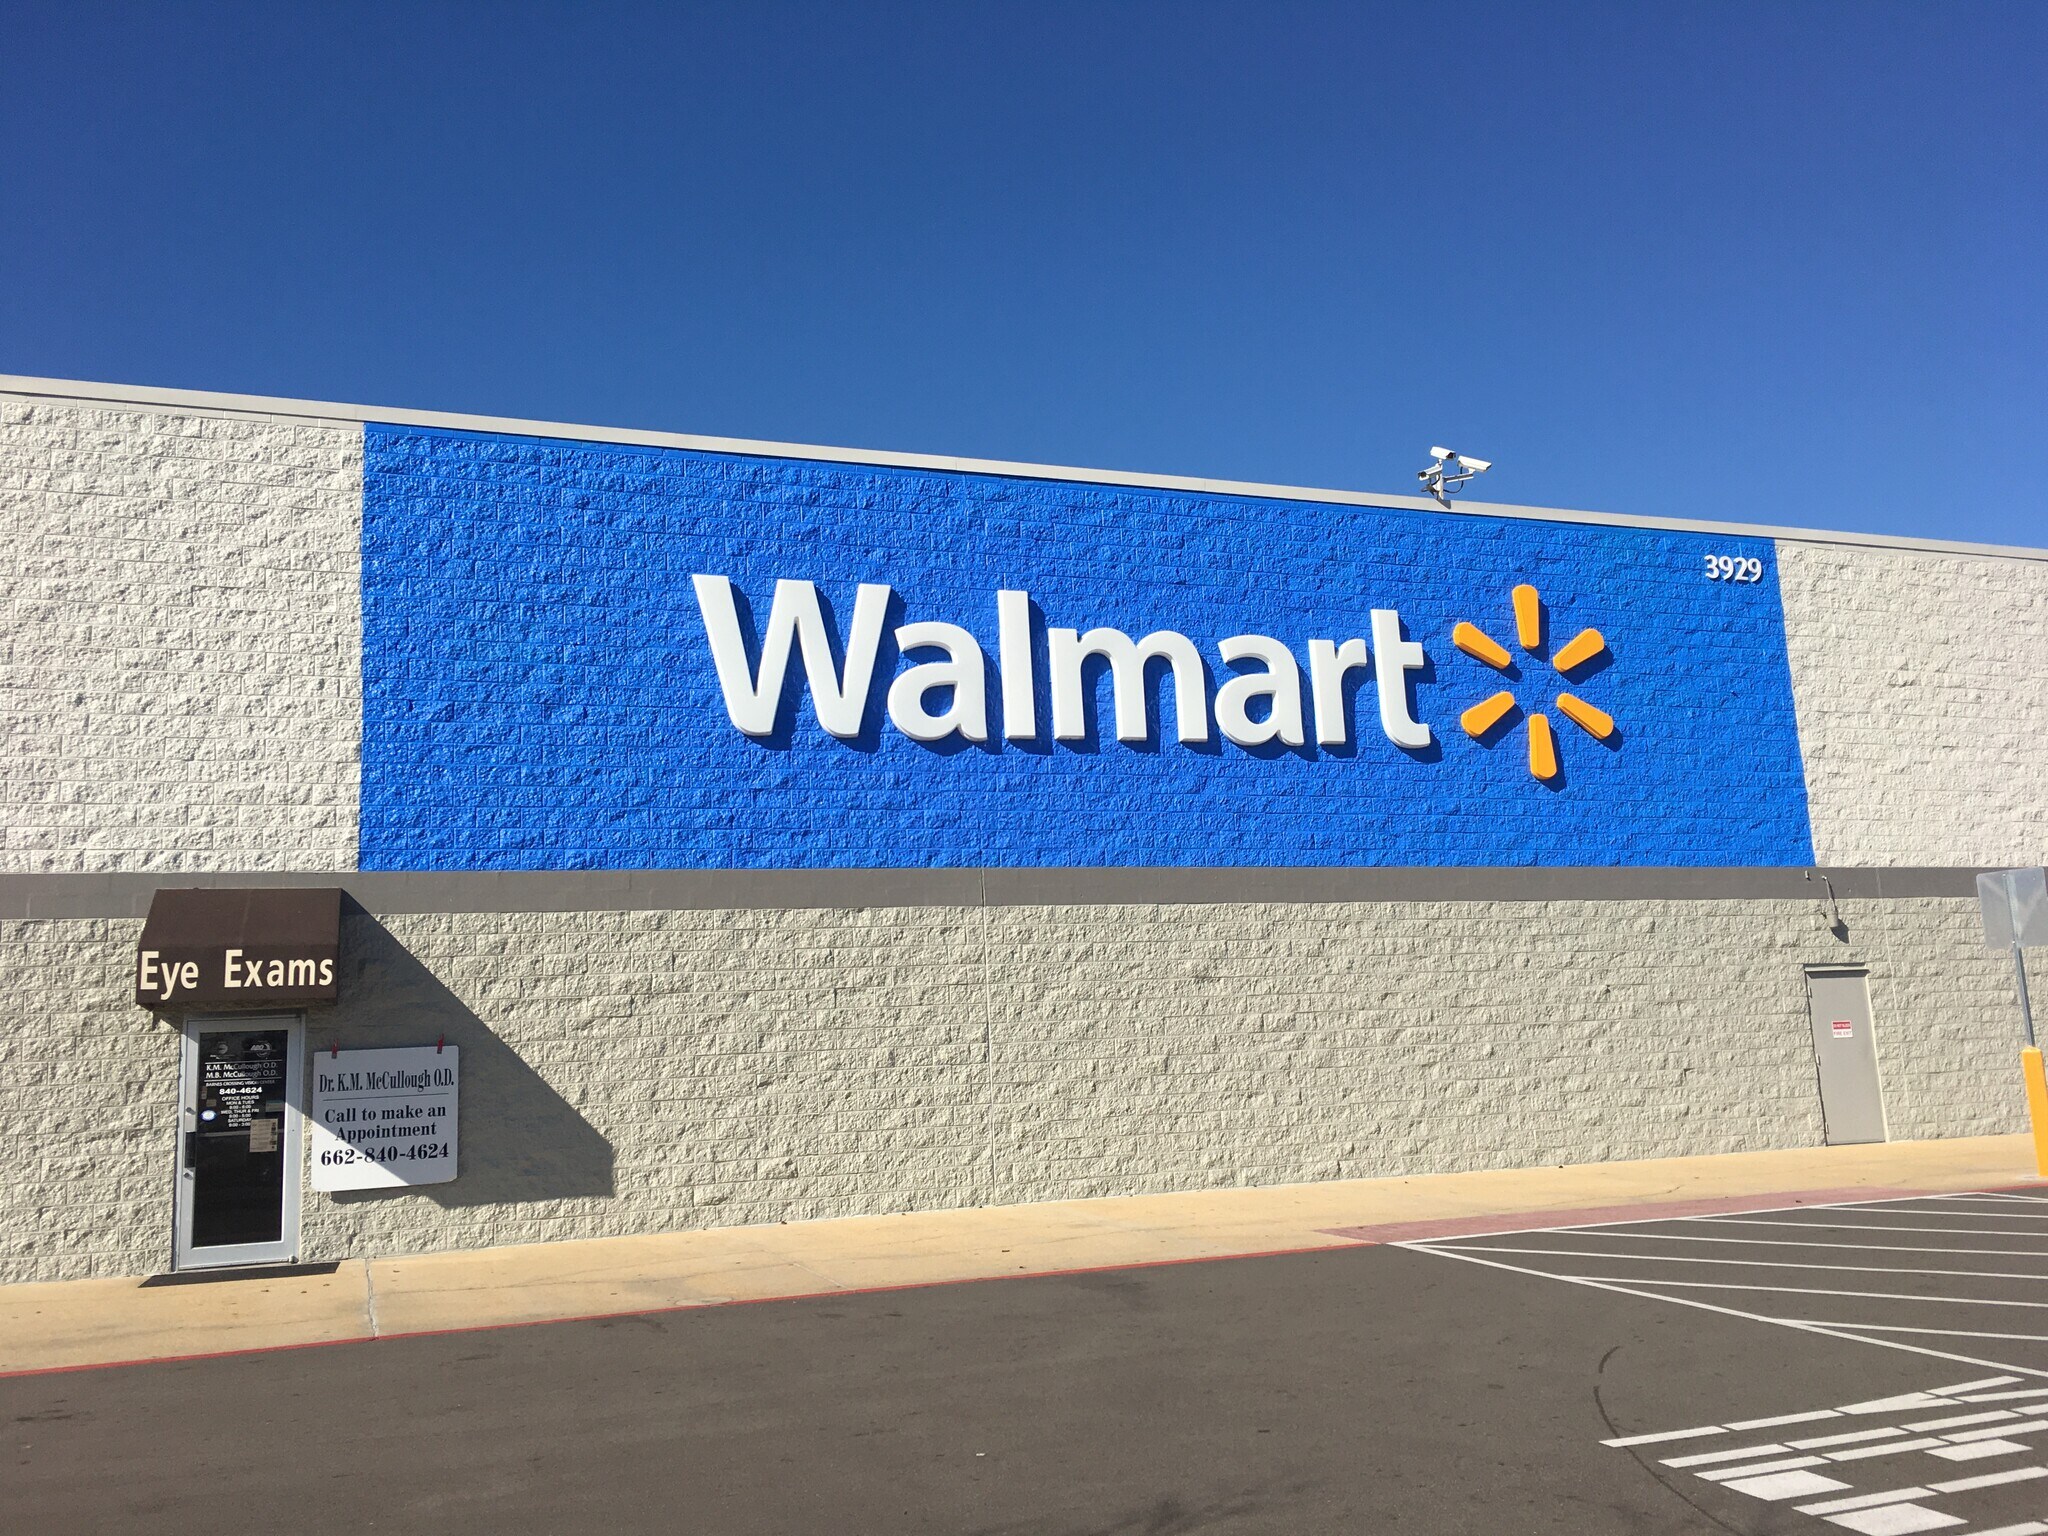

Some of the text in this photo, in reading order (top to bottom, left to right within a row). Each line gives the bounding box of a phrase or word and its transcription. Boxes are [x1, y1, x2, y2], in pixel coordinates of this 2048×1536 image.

[1704, 554, 1762, 583] 3929
[692, 573, 1430, 749] Walmart
[140, 949, 333, 1000] Eye Exams
[223, 1063, 261, 1071] McCullough
[223, 1071, 261, 1079] McCullough
[219, 1086, 262, 1095] 840-4624
[319, 1068, 455, 1093] Dr. K.M. McCullough O.D.
[325, 1105, 446, 1123] Call to make an
[335, 1122, 437, 1144] Appointment
[321, 1142, 449, 1166] 662-840-4624
